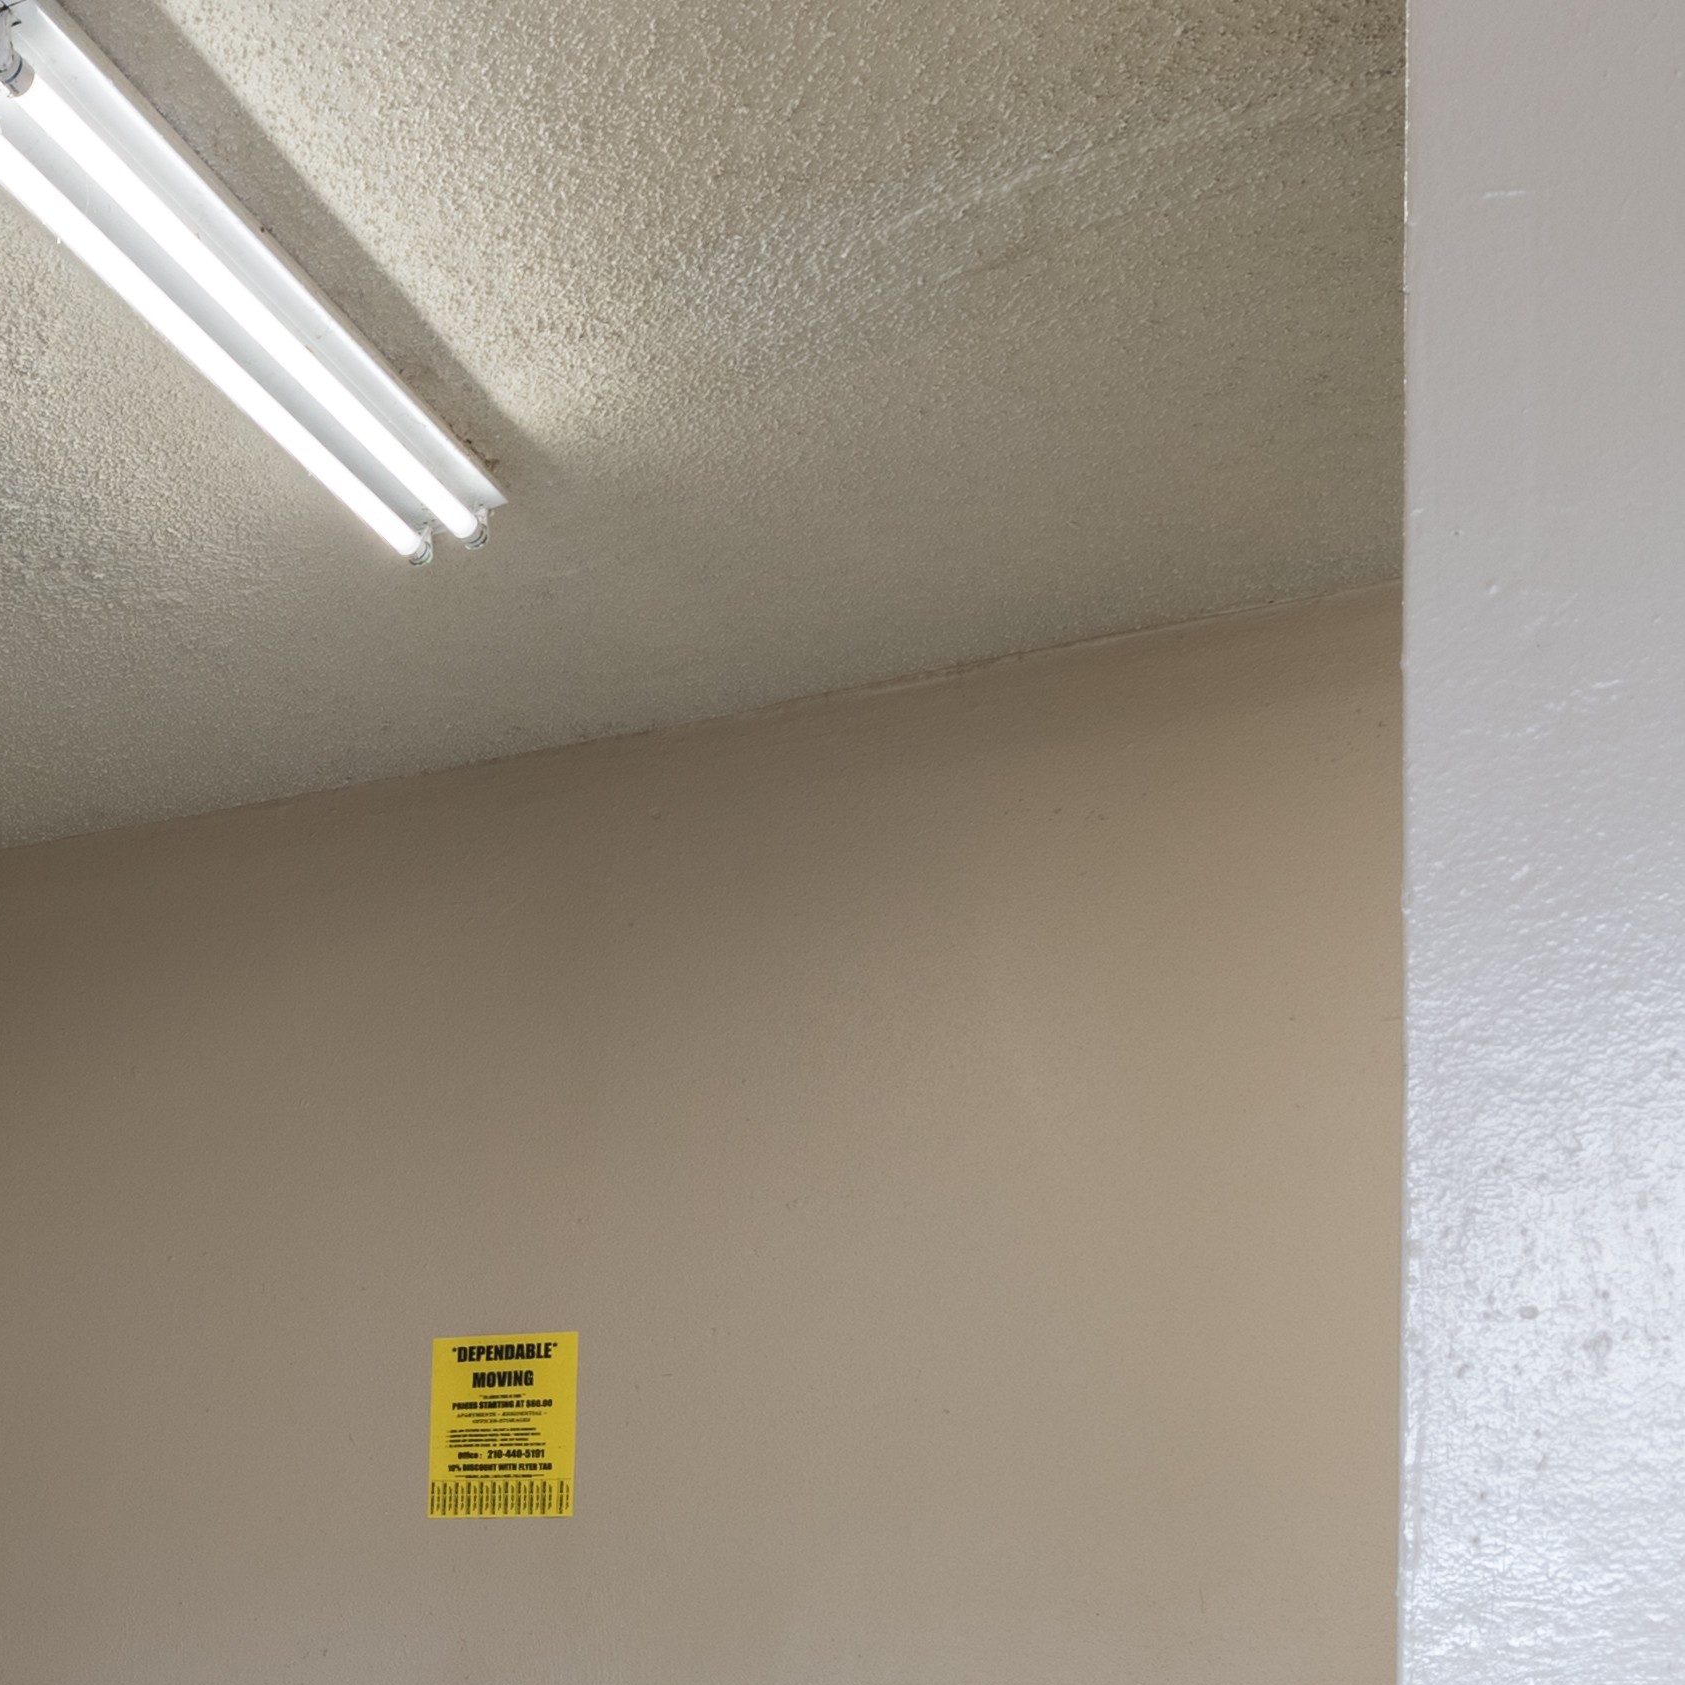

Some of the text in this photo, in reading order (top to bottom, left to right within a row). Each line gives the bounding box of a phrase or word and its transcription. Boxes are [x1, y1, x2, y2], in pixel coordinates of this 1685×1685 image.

[472, 1370, 534, 1388] MOVING
[479, 1400, 514, 1409] STARTING
[516, 1400, 524, 1408] AT
[463, 1463, 496, 1471] DISCOUNT
[498, 1463, 517, 1471] WITH
